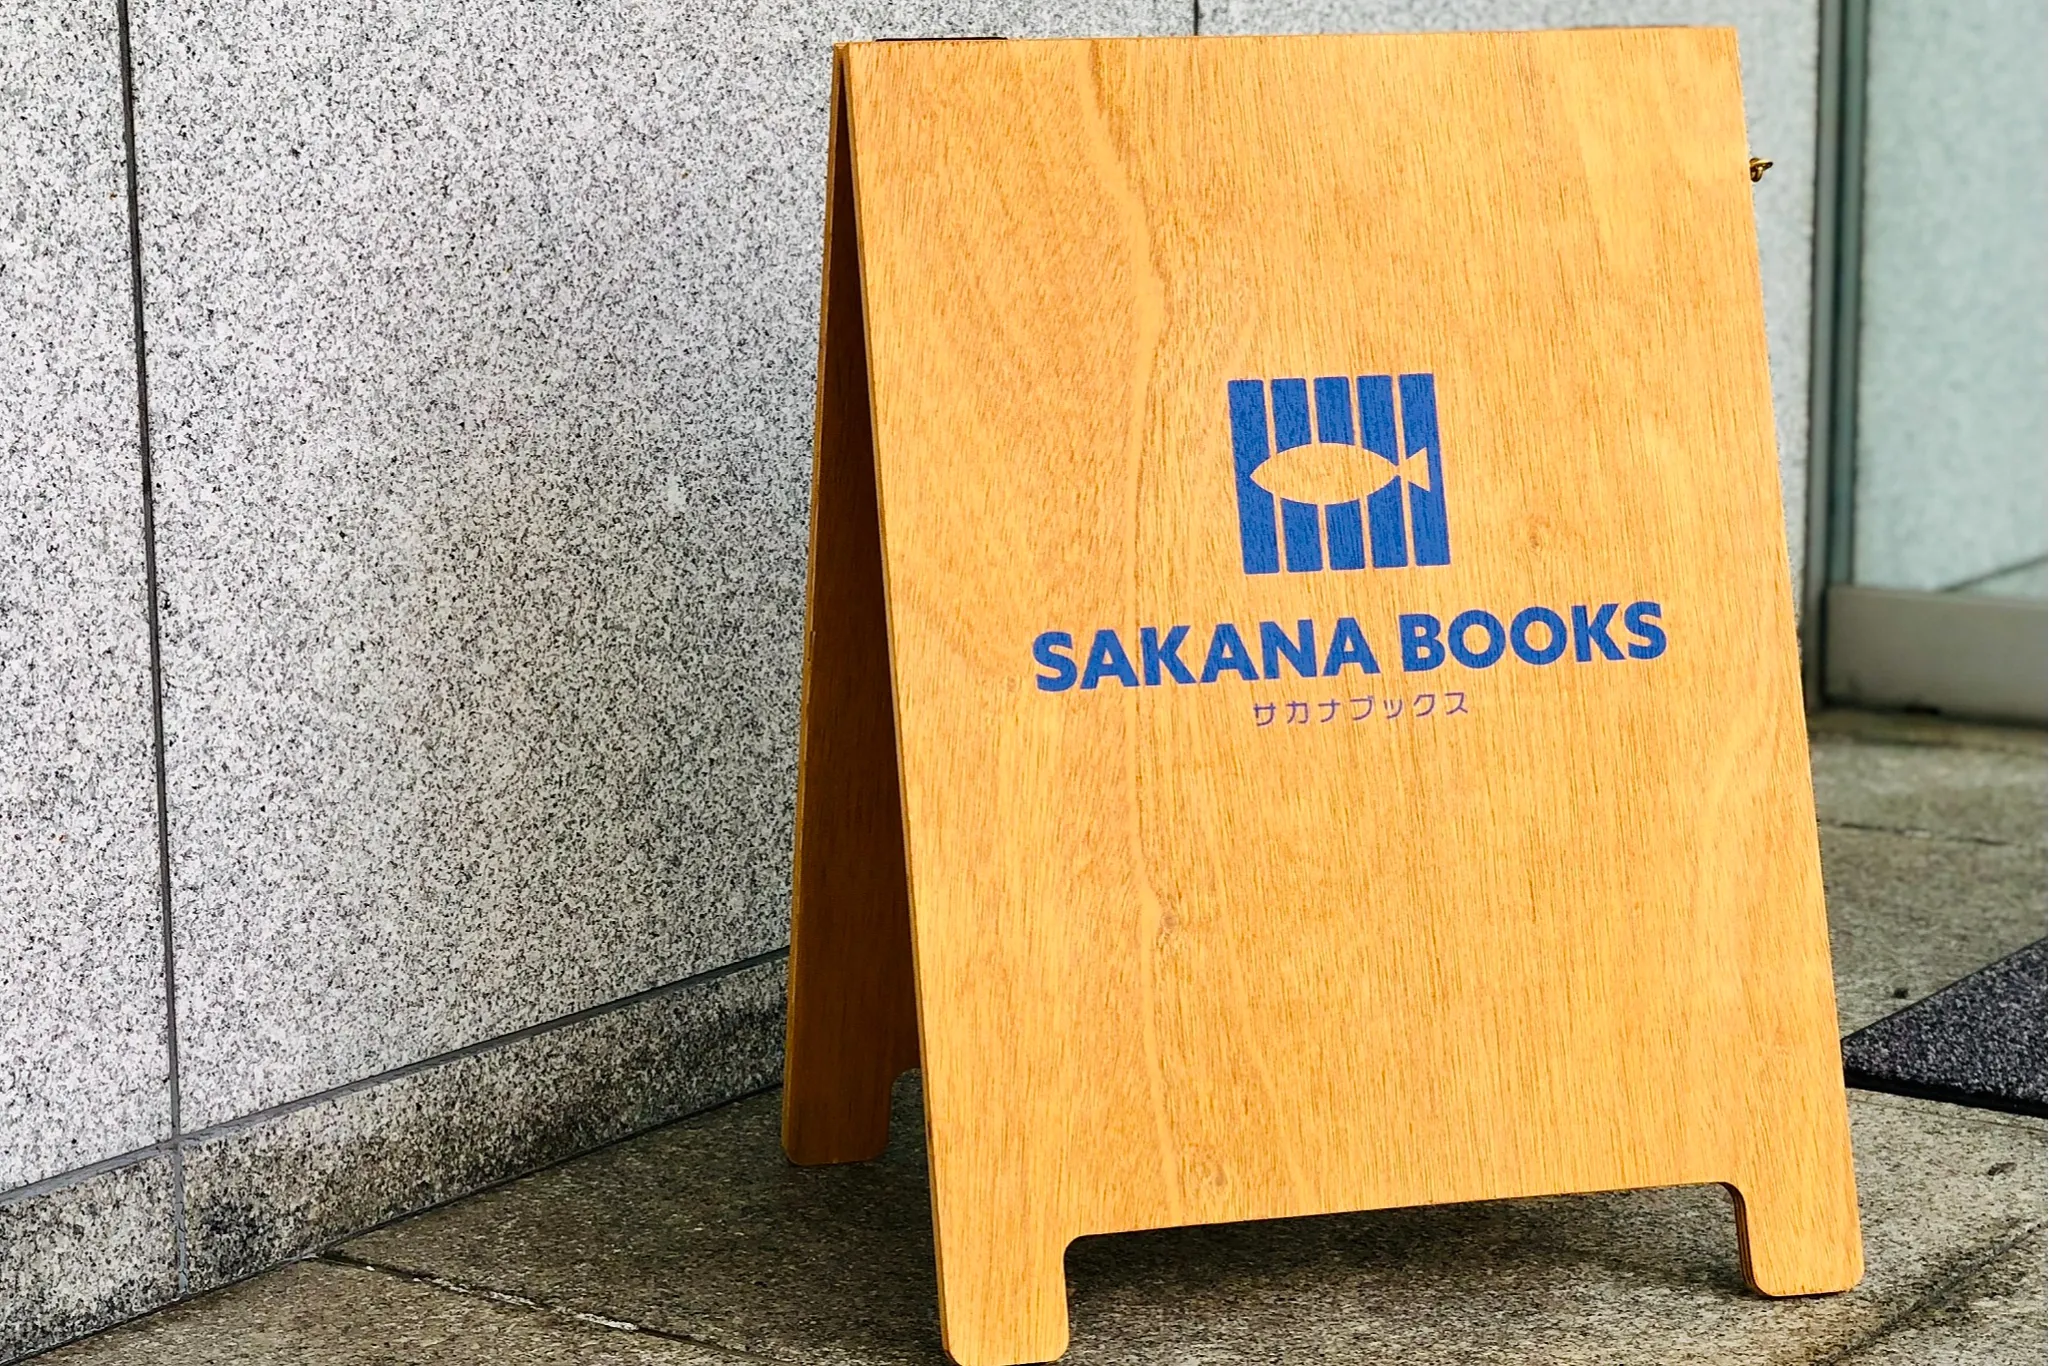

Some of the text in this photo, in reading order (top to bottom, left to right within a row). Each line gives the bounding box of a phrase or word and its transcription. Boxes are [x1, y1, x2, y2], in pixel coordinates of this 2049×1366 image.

[1033, 602, 1667, 692] SAKANA BOOKS
[1253, 692, 1469, 727] サカナブックス
